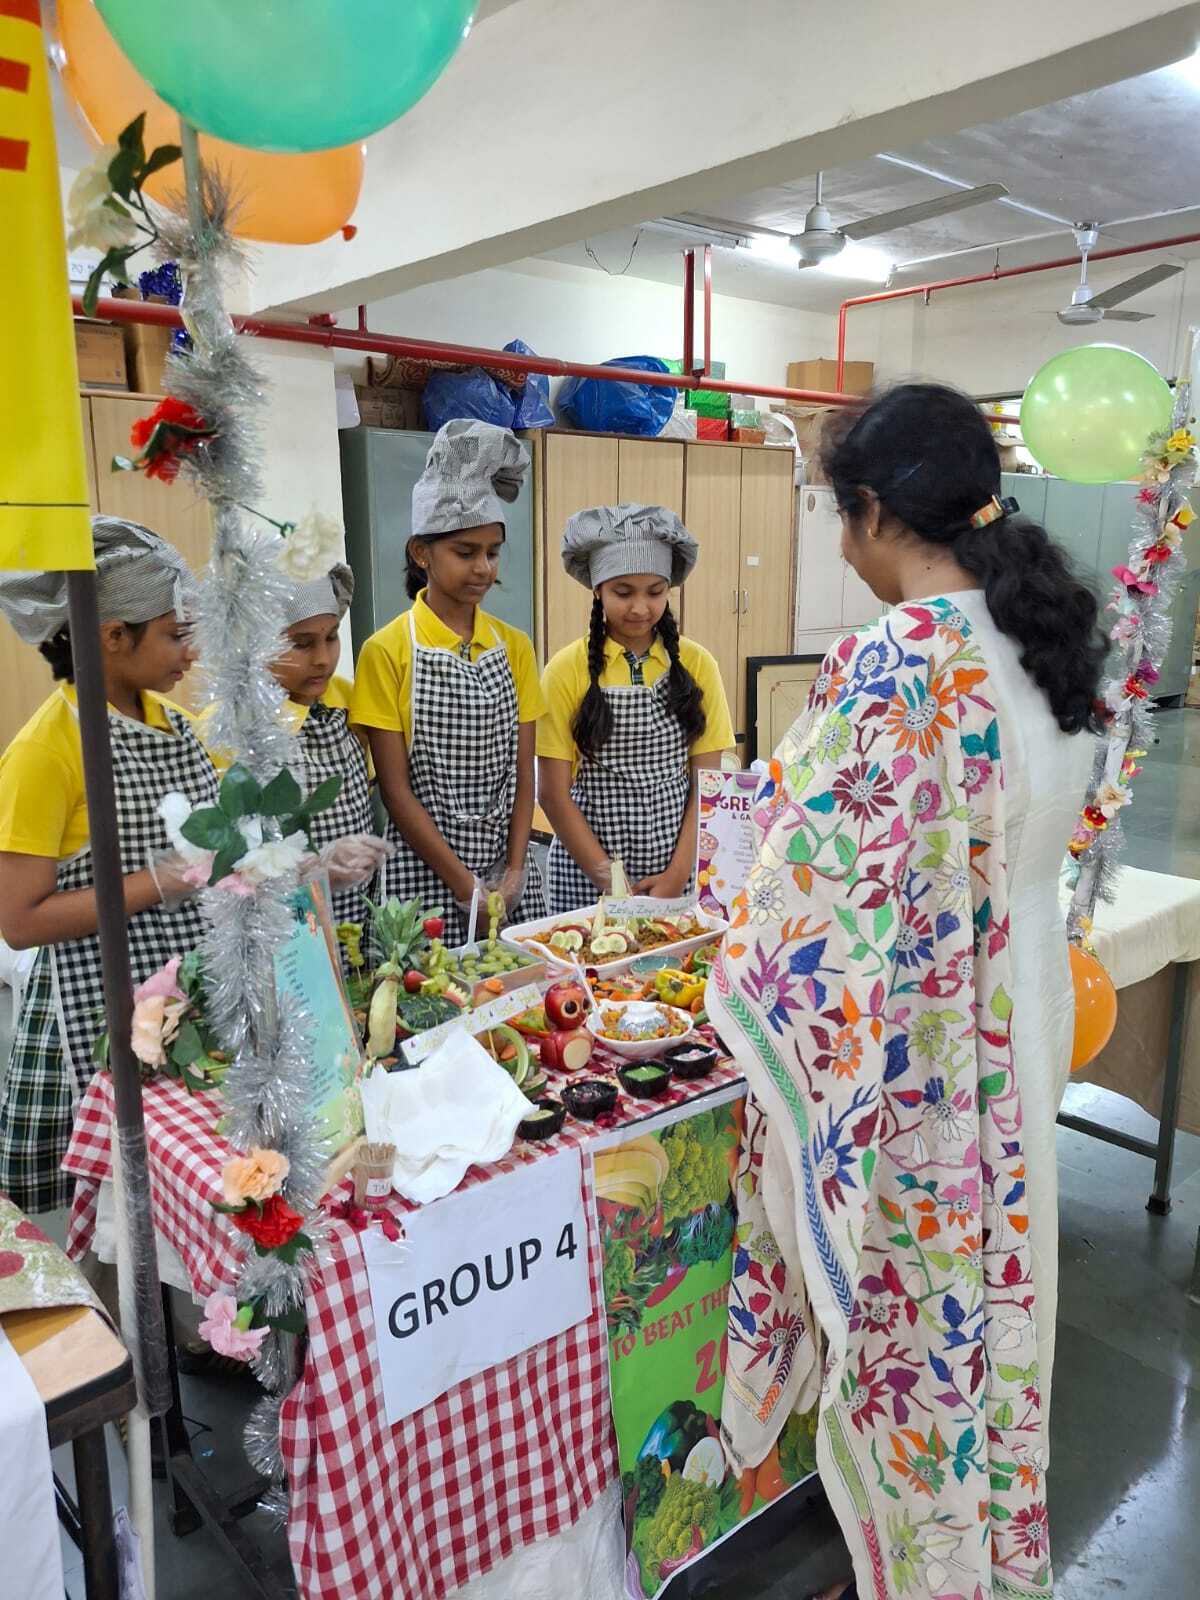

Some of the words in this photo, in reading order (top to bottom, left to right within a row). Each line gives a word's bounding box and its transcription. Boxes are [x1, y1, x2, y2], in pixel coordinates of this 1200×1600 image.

[388, 1238, 542, 1339] GROUP
[555, 1222, 578, 1260] 4
[612, 1333, 637, 1361] TO
[642, 1302, 695, 1346] BEAT
[699, 1283, 730, 1316] THE
